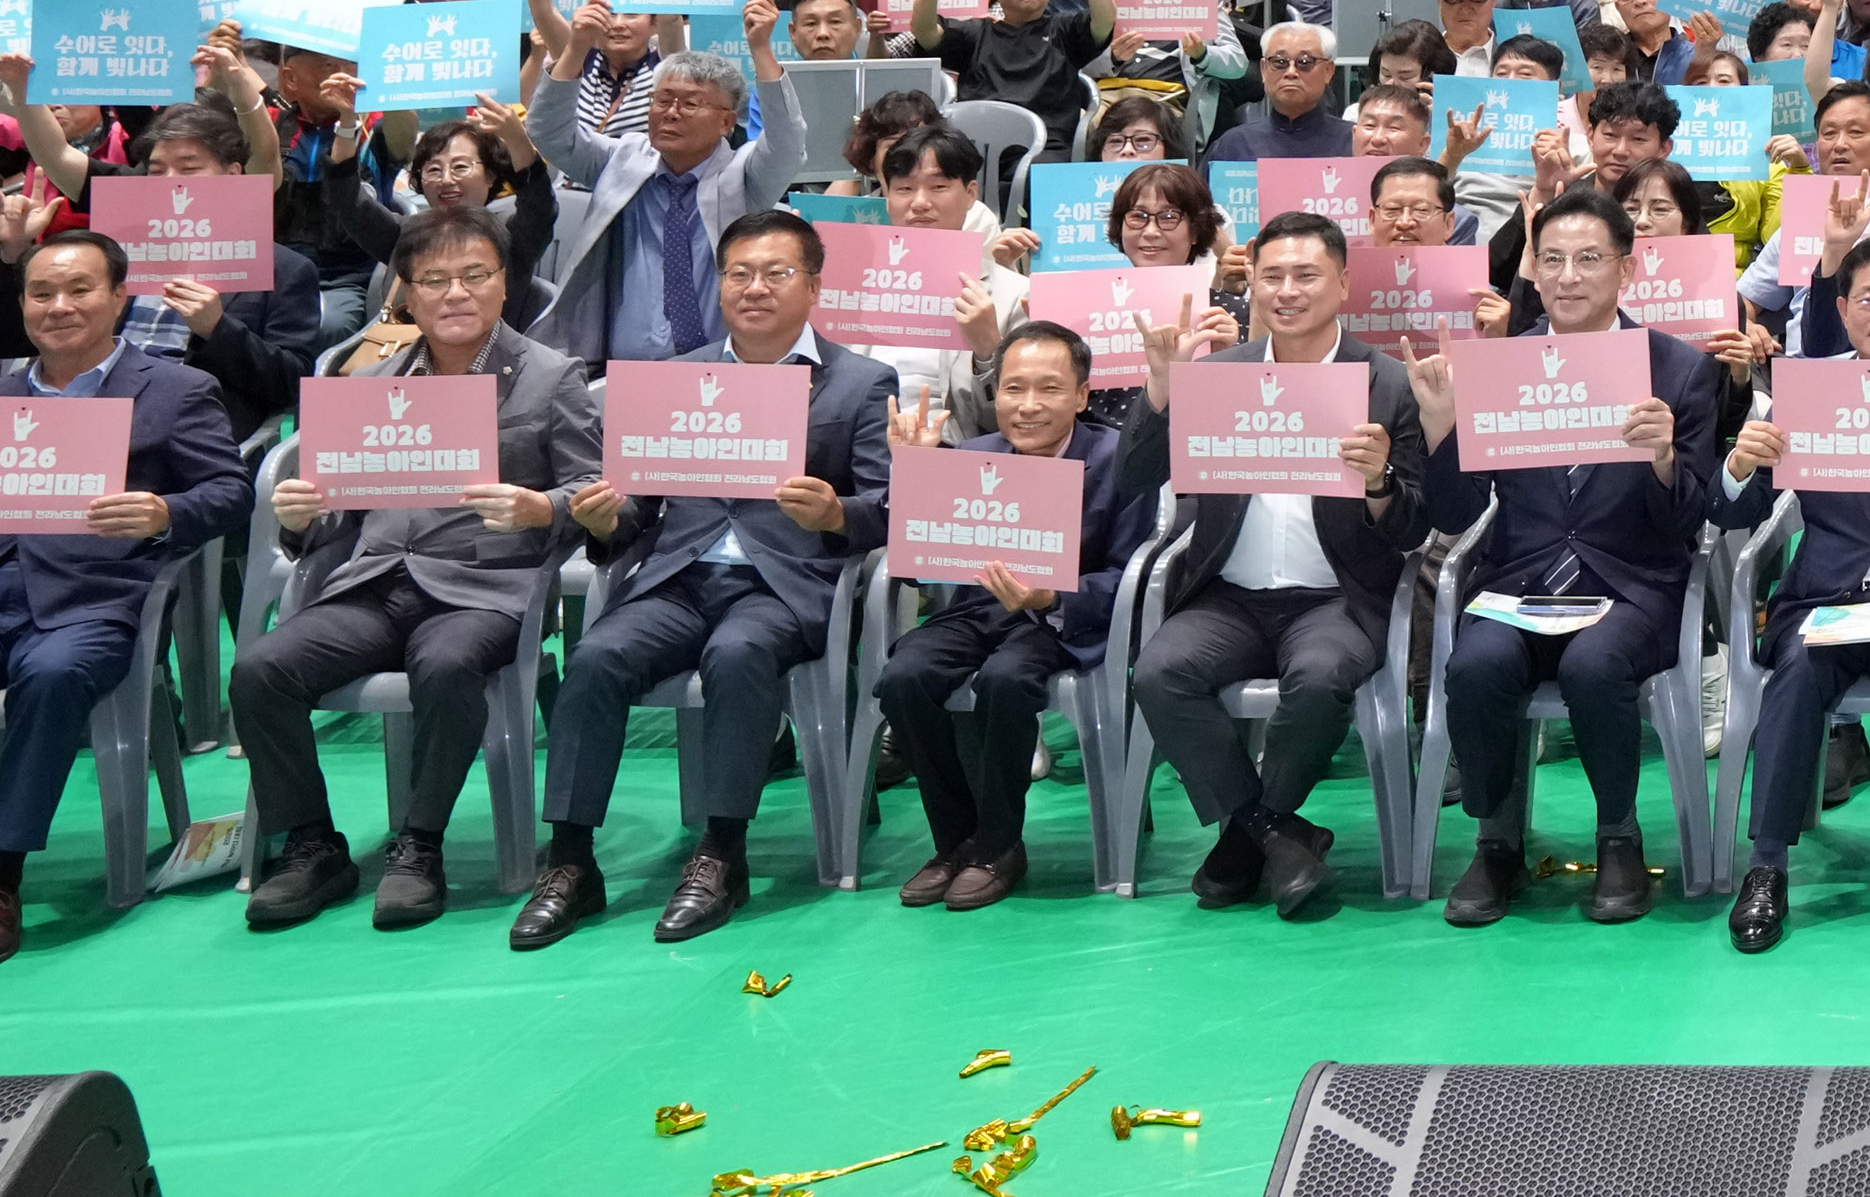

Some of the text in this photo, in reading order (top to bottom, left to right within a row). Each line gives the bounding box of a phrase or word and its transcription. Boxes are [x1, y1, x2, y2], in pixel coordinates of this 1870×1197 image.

[1117, 7, 1209, 20] 전남농아인대회
[55, 35, 174, 58] 수어로 잇다,
[57, 57, 169, 77] 함께 빛나다
[1303, 198, 1358, 215] 2026
[148, 219, 211, 238] 2026
[122, 240, 256, 261] 남농아인대회
[862, 268, 922, 290] 2026
[1371, 289, 1433, 309] 2026
[1518, 382, 1588, 405] 2026
[670, 410, 742, 433] 2026
[1235, 411, 1304, 432] 2026
[363, 424, 432, 446] 2026
[621, 436, 788, 462] 전남농아인대회
[316, 449, 480, 474] 전남농아인대회
[644, 472, 777, 485] (사)한국농아인협회 전라남도협회
[1213, 469, 1342, 482] (사)한국농아인협회 전라남도협회
[341, 486, 416, 498] (사)한국농아인협회
[953, 498, 1021, 522] 2026
[906, 520, 1064, 553] 전남농아인대회
